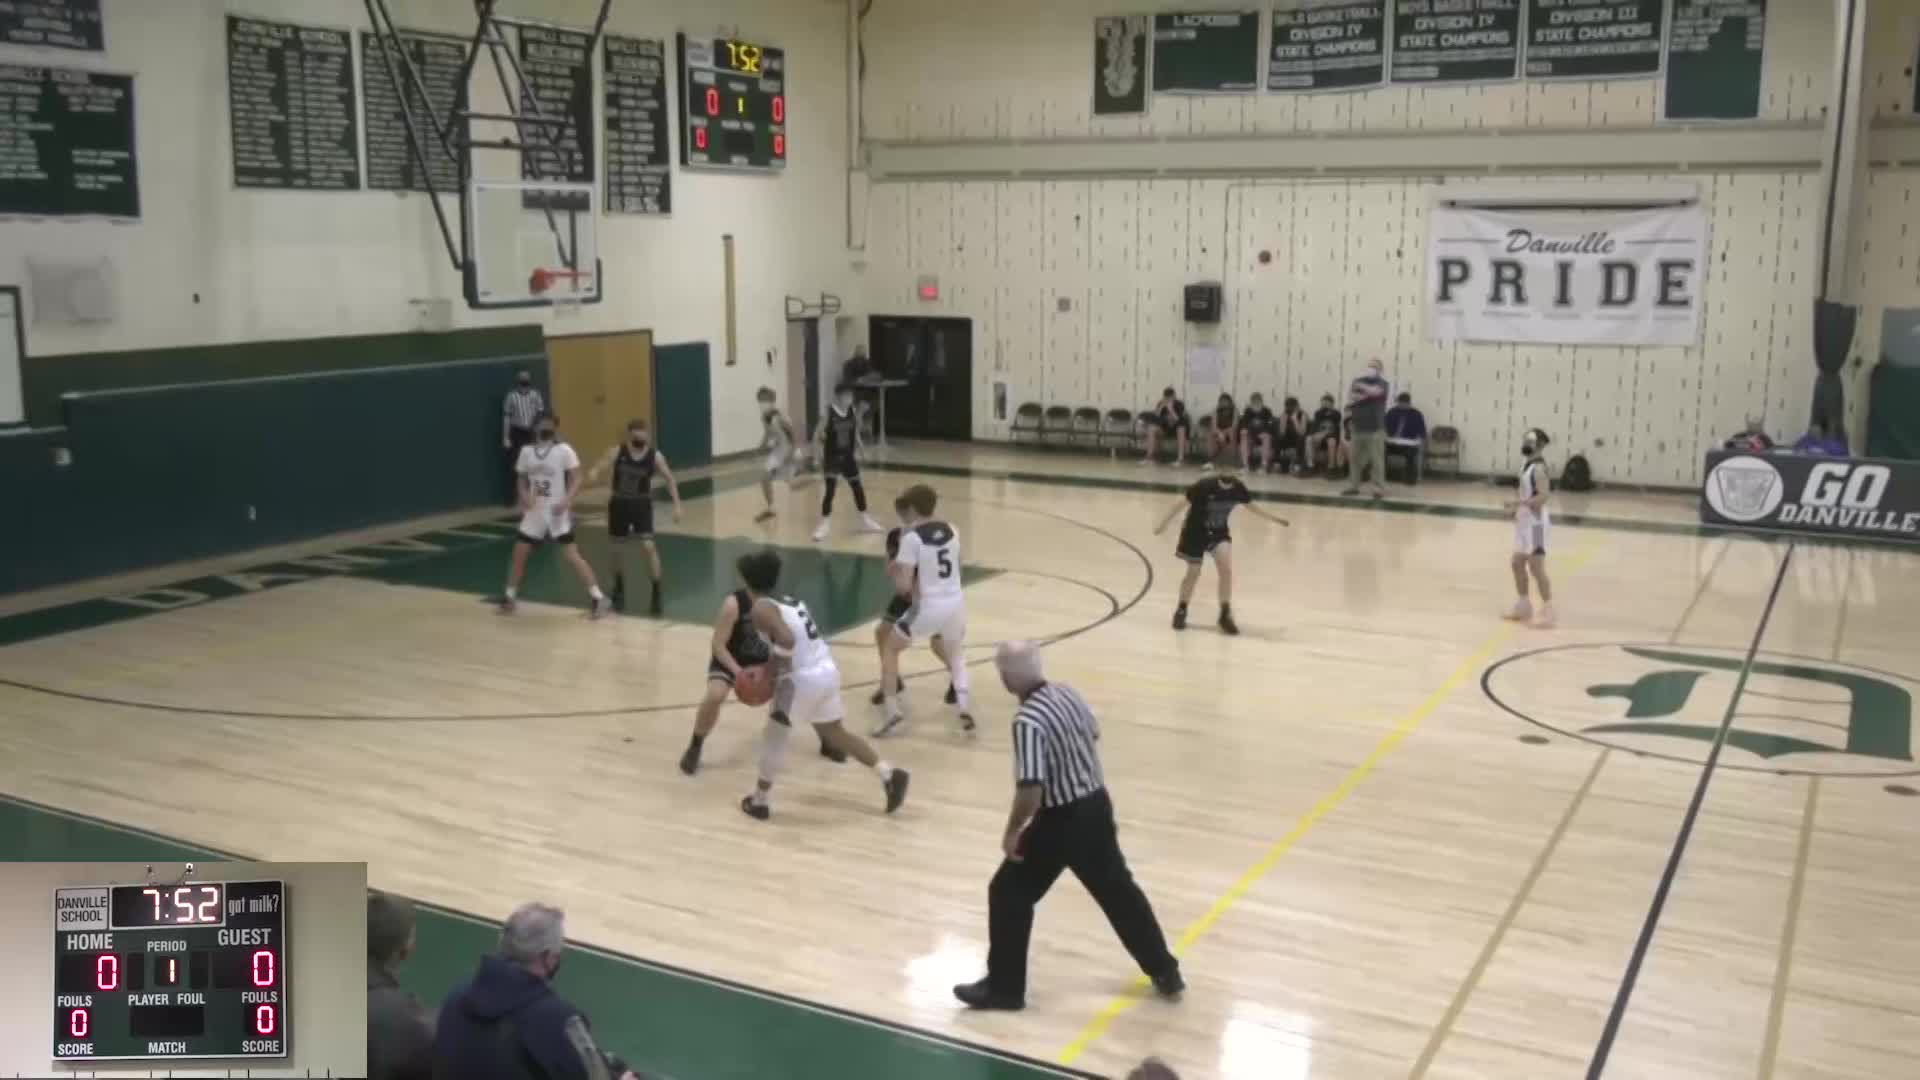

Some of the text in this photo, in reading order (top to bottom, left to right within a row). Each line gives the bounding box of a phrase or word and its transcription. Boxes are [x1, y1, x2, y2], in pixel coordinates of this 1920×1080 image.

[1415, 13, 1495, 31] DIVISION IV
[1550, 7, 1613, 24] DIVISION
[1289, 26, 1344, 41] DIVISION
[1400, 30, 1509, 49] STATE CHAMPIONS
[1535, 27, 1573, 42] STATE
[1578, 22, 1652, 40] CHAMPIONS
[1275, 45, 1311, 58] STATE
[1313, 38, 1377, 56] CHAMPIONS
[705, 87, 784, 124] 0 1 0
[694, 126, 707, 150] 0
[773, 133, 785, 157] 0
[1506, 228, 1616, 255] Danville
[1434, 257, 1694, 308] PRIDE
[1801, 462, 1890, 510] GO
[1777, 503, 1920, 532] DANVILLE
[937, 548, 953, 580] 5
